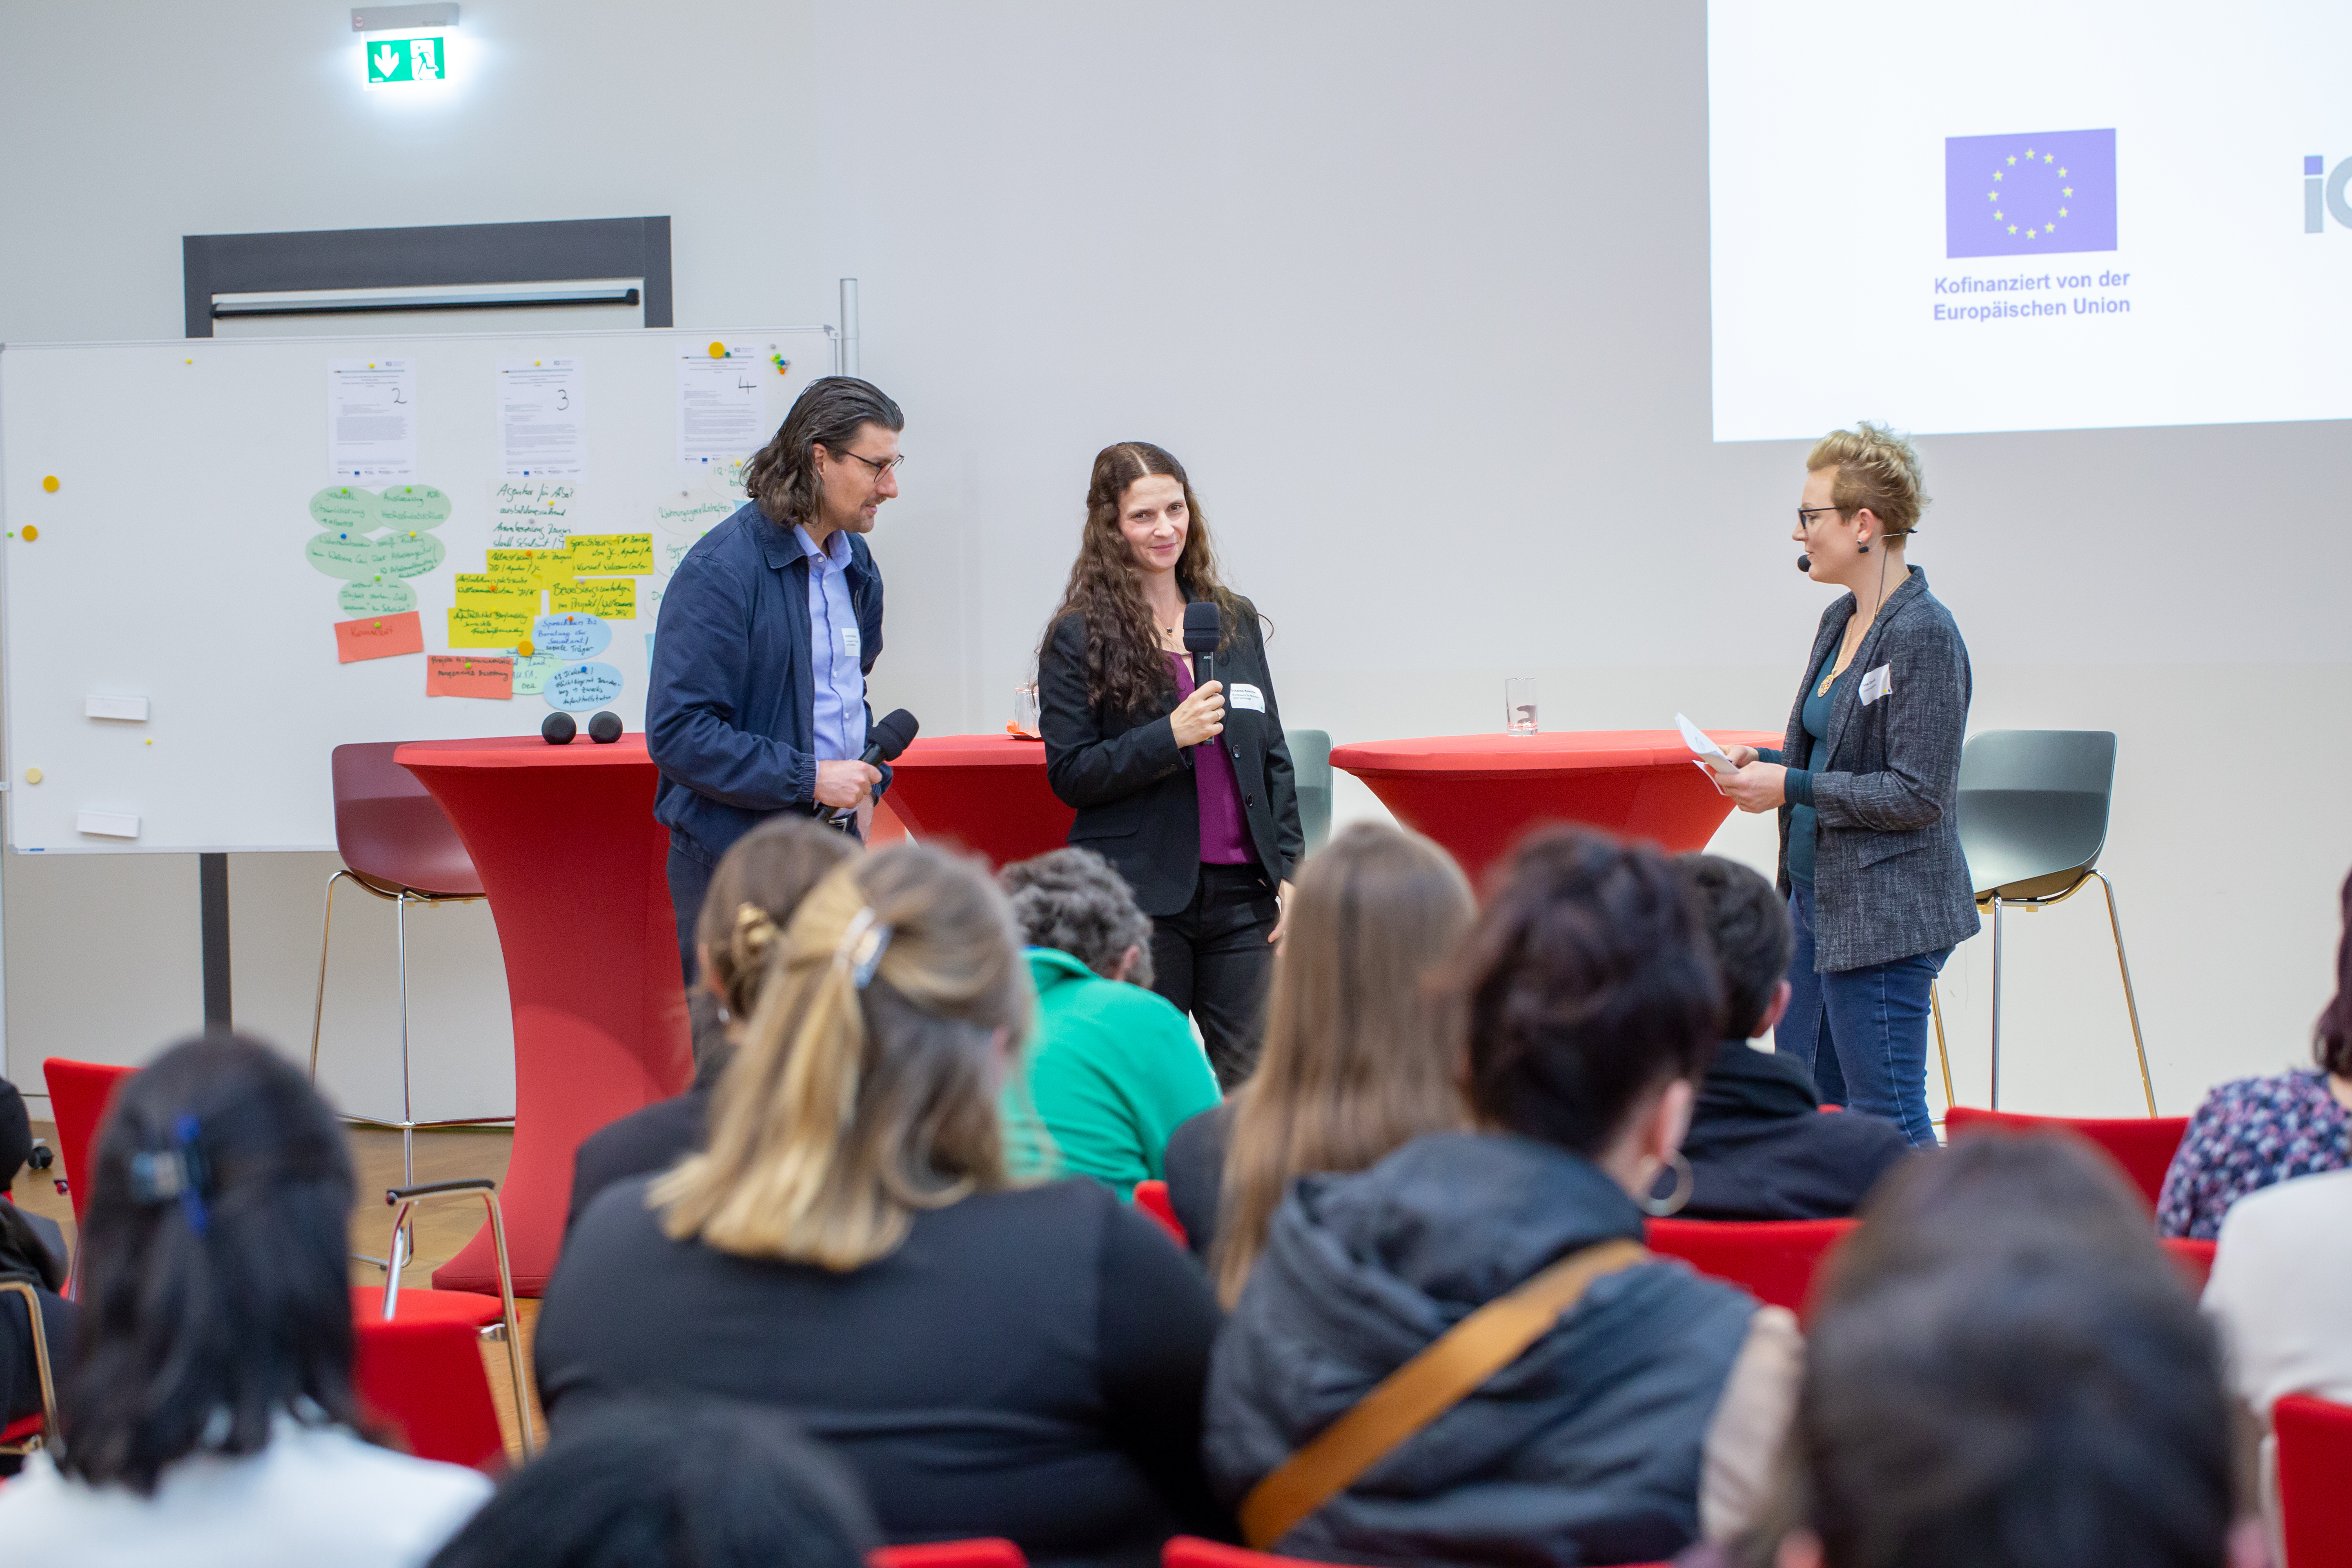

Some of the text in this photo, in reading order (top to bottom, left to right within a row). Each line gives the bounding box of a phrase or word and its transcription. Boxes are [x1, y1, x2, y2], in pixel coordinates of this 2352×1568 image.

[1934, 270, 2130, 294] Kofinanziert von der
[1933, 296, 2130, 322] Europäischen Union
[739, 375, 757, 394] 4
[392, 388, 408, 404] 2
[557, 389, 569, 411] 3
